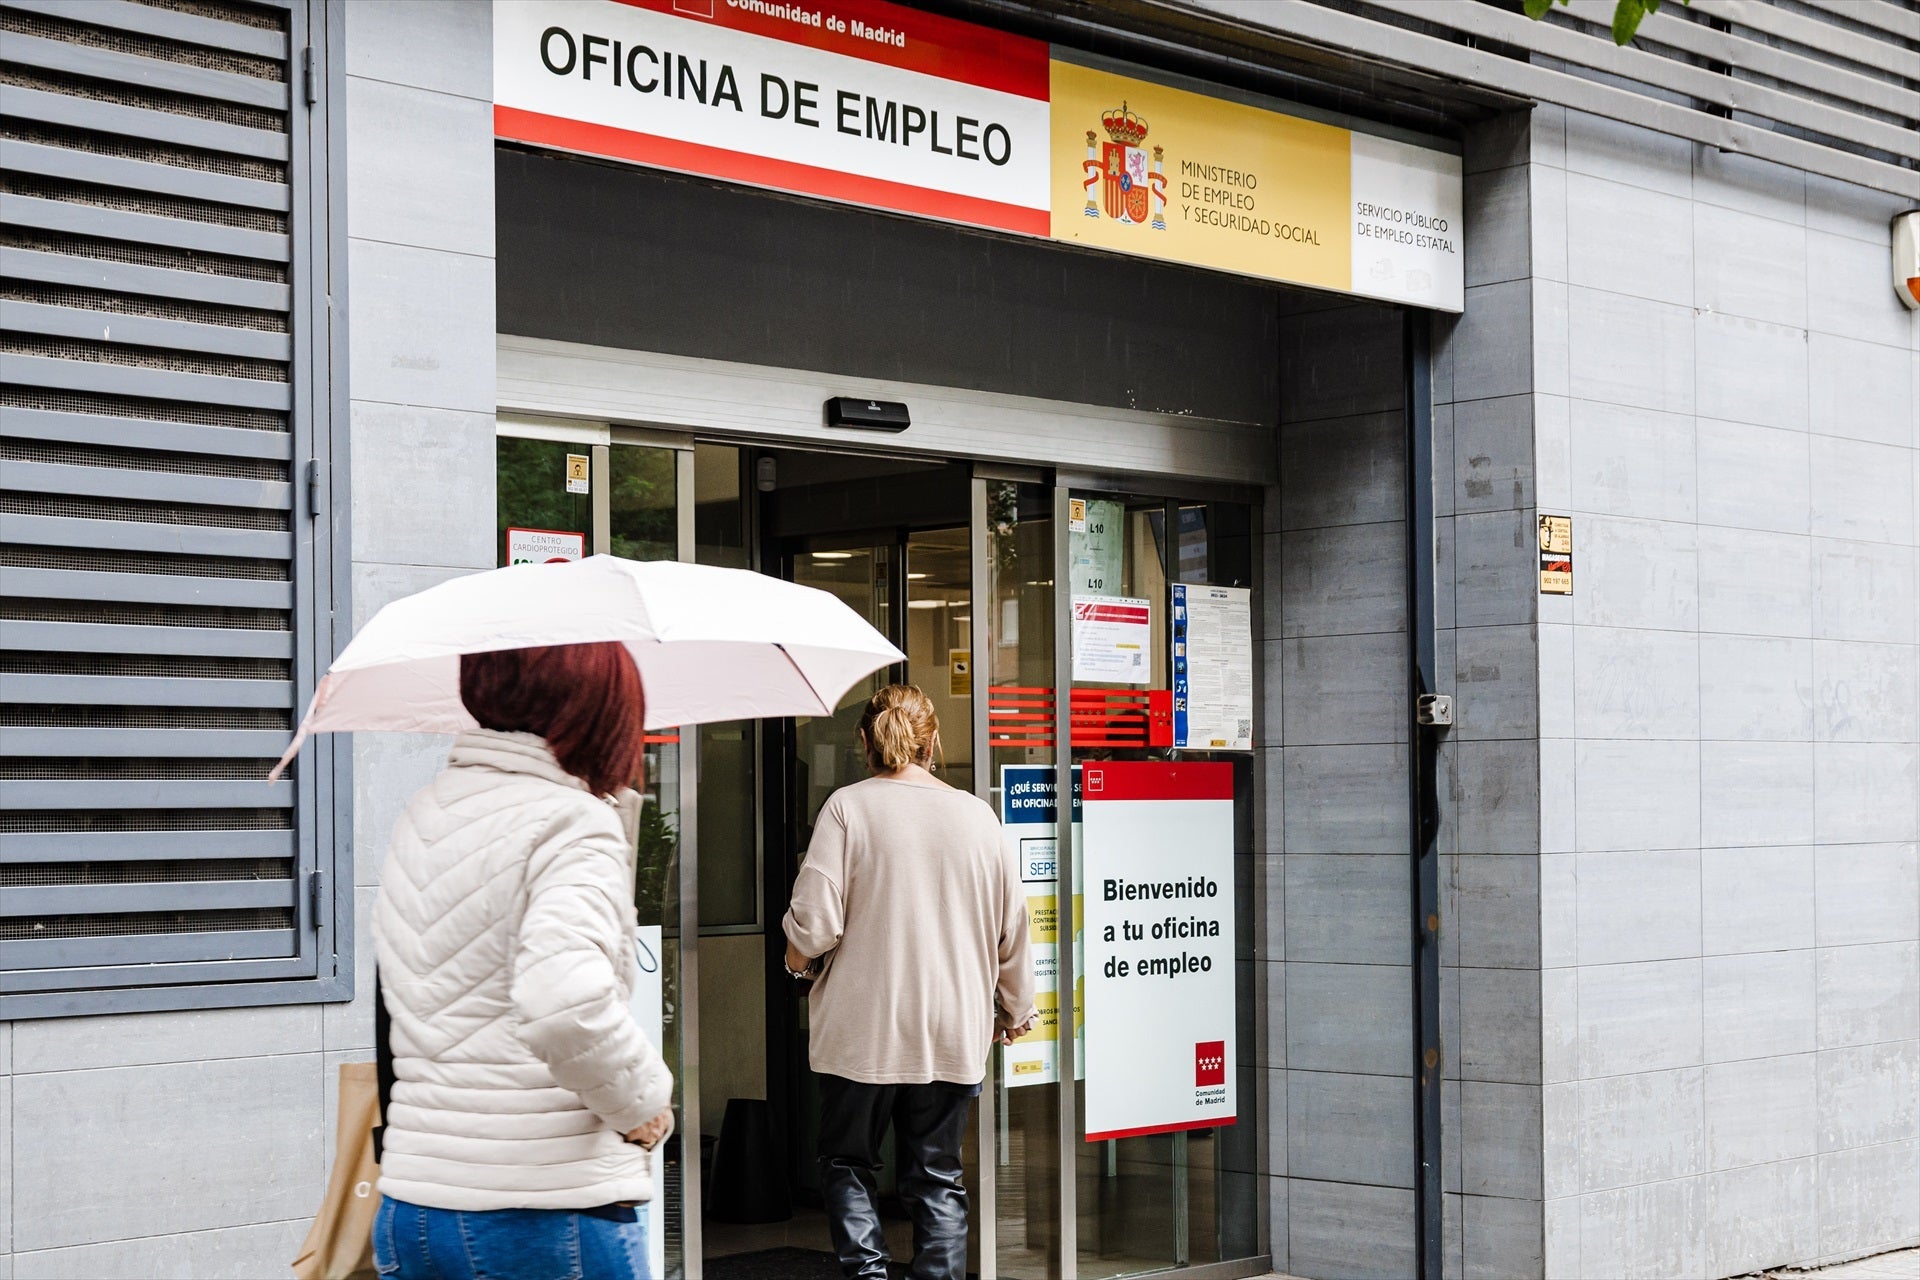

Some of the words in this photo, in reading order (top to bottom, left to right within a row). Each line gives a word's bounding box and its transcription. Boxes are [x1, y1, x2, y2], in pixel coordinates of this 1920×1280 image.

[826, 15, 846, 33] de
[851, 20, 905, 47] Madrid
[540, 26, 743, 112] OFICINA
[760, 72, 819, 128] DE
[837, 90, 1012, 166] EMPLEO
[1181, 160, 1257, 189] MINISTERIO
[1182, 183, 1199, 201] DE
[1205, 188, 1254, 211] EMPLEO
[1182, 204, 1190, 220] Y
[1194, 207, 1270, 237] SEGURIDAD
[1274, 224, 1320, 246] SOCIAL
[1357, 202, 1402, 224] SERVICIO
[1405, 210, 1448, 232] PÚBLICO
[1357, 222, 1371, 237] DE
[1374, 225, 1413, 245] EMPLEO
[1416, 233, 1455, 254] ESTATAL
[531, 536, 561, 545] CENTRO
[1090, 523, 1104, 534] L10
[513, 543, 578, 555] CARDIOPROTEGIDO
[1088, 579, 1103, 589] L10
[1010, 781, 1030, 795] ¿QUÉ
[1011, 799, 1022, 808] EN
[1030, 862, 1056, 875] SEPE
[1103, 876, 1217, 901] Bienvenido
[1103, 925, 1115, 942] a
[1123, 920, 1143, 941] tu
[1151, 916, 1220, 939] oficina
[1104, 956, 1129, 978] de
[1137, 951, 1212, 979] empleo
[1195, 1088, 1225, 1097] Comunidad
[1195, 1098, 1203, 1106] de
[1205, 1096, 1225, 1105] Madrid
